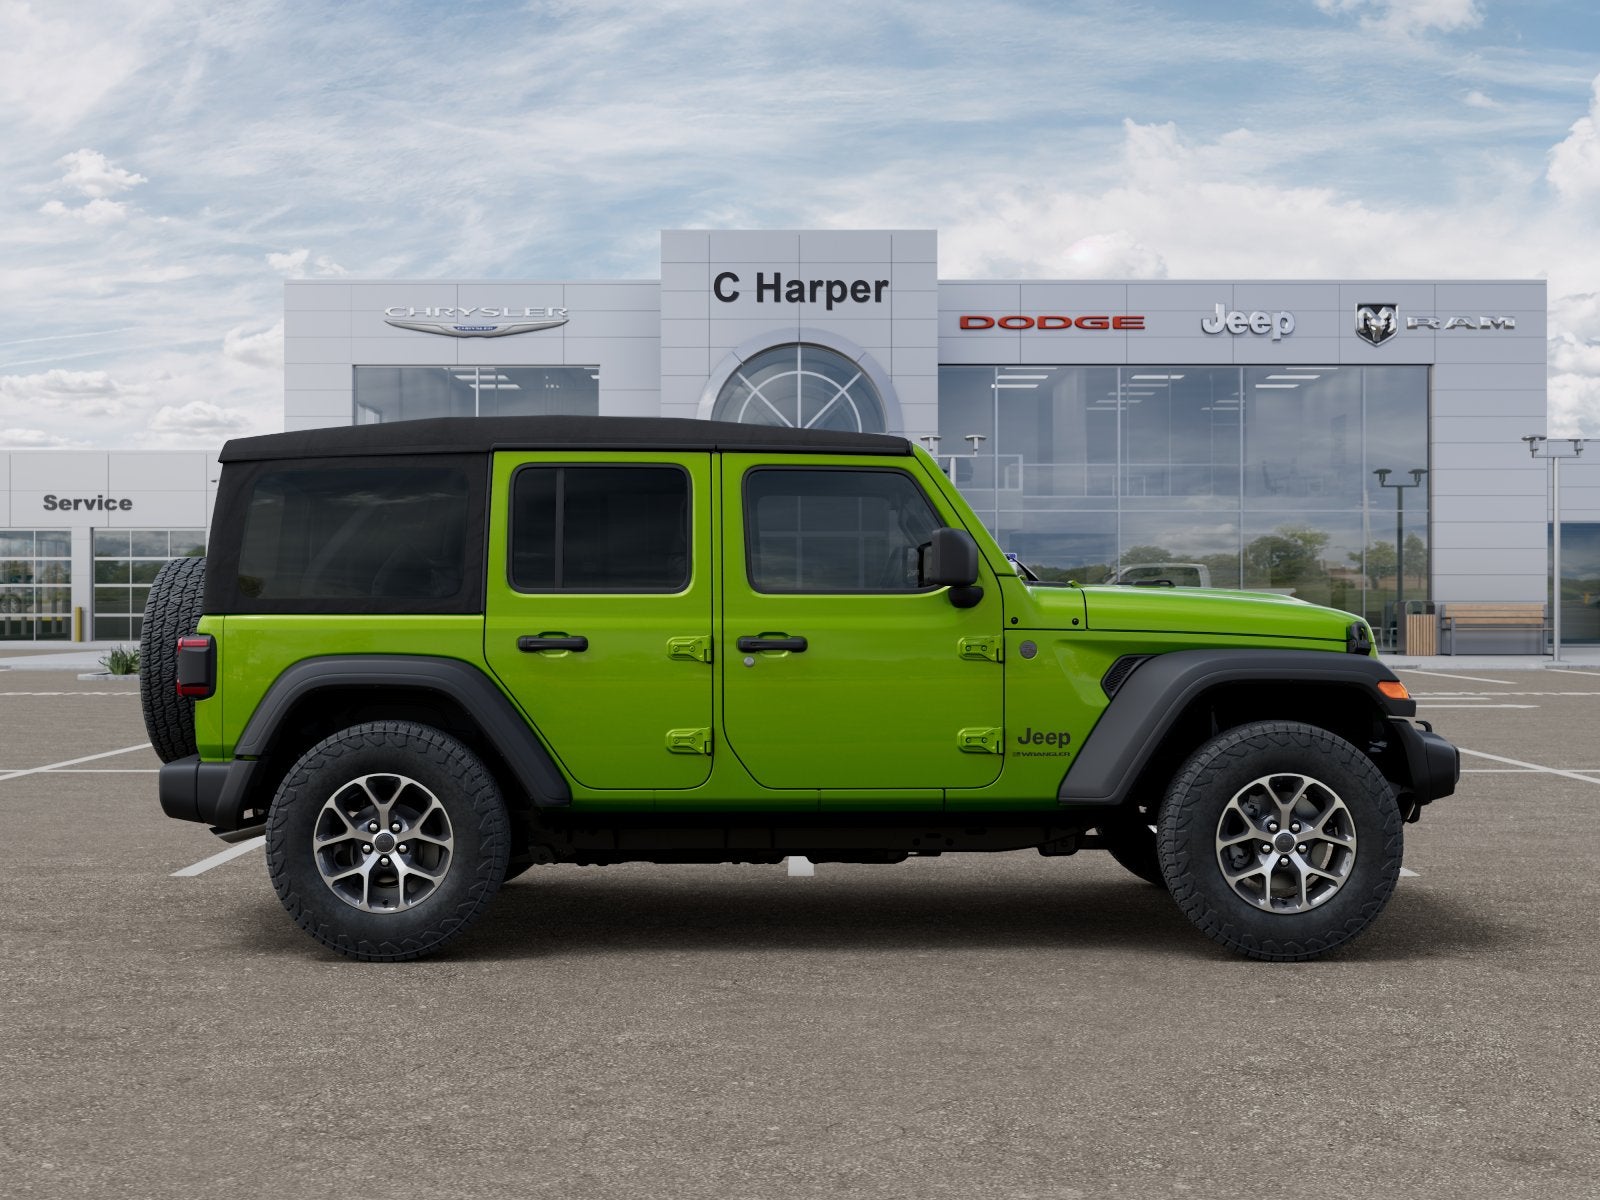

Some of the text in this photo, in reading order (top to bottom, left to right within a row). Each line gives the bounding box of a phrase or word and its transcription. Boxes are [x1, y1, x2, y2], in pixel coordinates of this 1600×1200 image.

[713, 271, 890, 311] C Harper
[384, 306, 569, 317] CHRYSLER
[959, 315, 1146, 330] DODGE
[1201, 303, 1296, 341] Jeep
[1406, 315, 1516, 330] RAM
[43, 494, 133, 511] Service
[1017, 727, 1071, 749] Jeep
